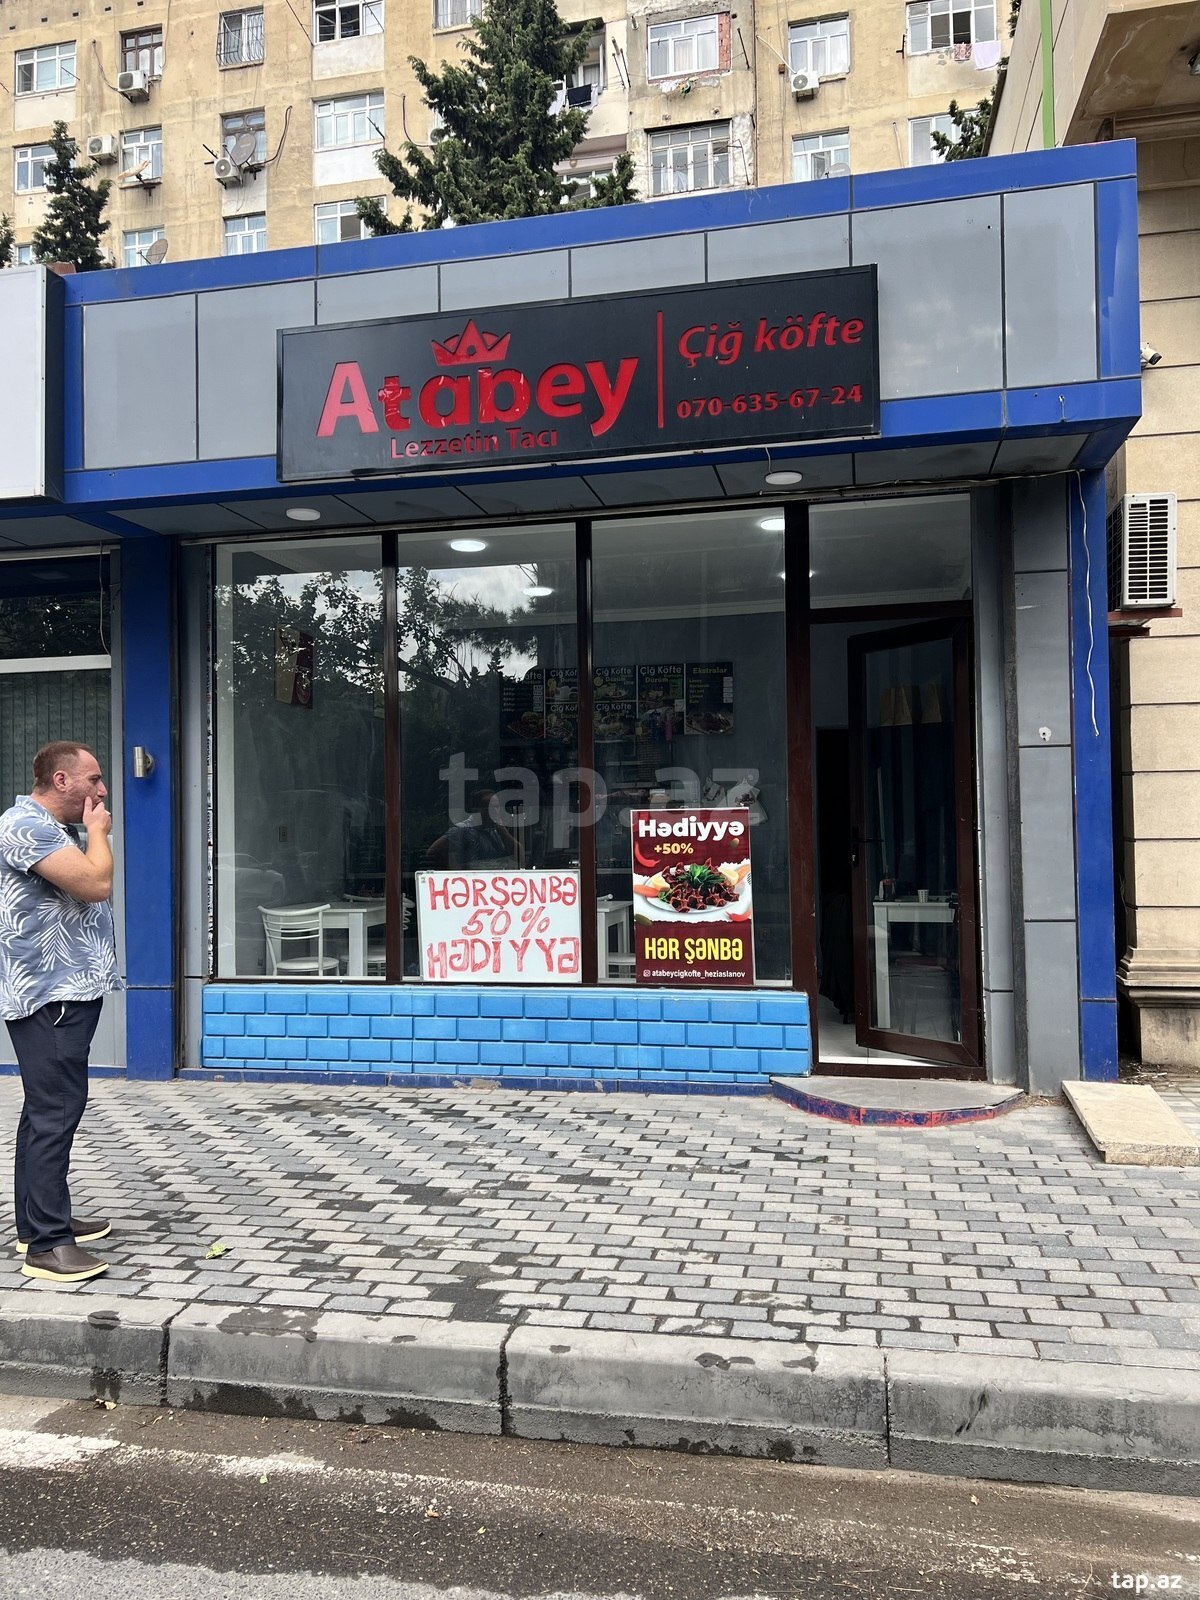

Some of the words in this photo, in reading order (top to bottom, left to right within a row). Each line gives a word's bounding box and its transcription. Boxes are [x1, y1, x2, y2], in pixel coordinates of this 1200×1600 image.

[678, 321, 743, 368] Çiğ
[754, 311, 864, 353] köfte
[316, 356, 639, 437] Atabey
[676, 384, 863, 419] 070-635-67-24
[390, 430, 499, 460] Lezzetin
[505, 427, 557, 449] Tacı
[638, 815, 745, 842] Hədiyyə
[654, 843, 694, 855] +50%
[644, 937, 680, 960] HƏR
[684, 937, 743, 964] ŞƏNBƏ
